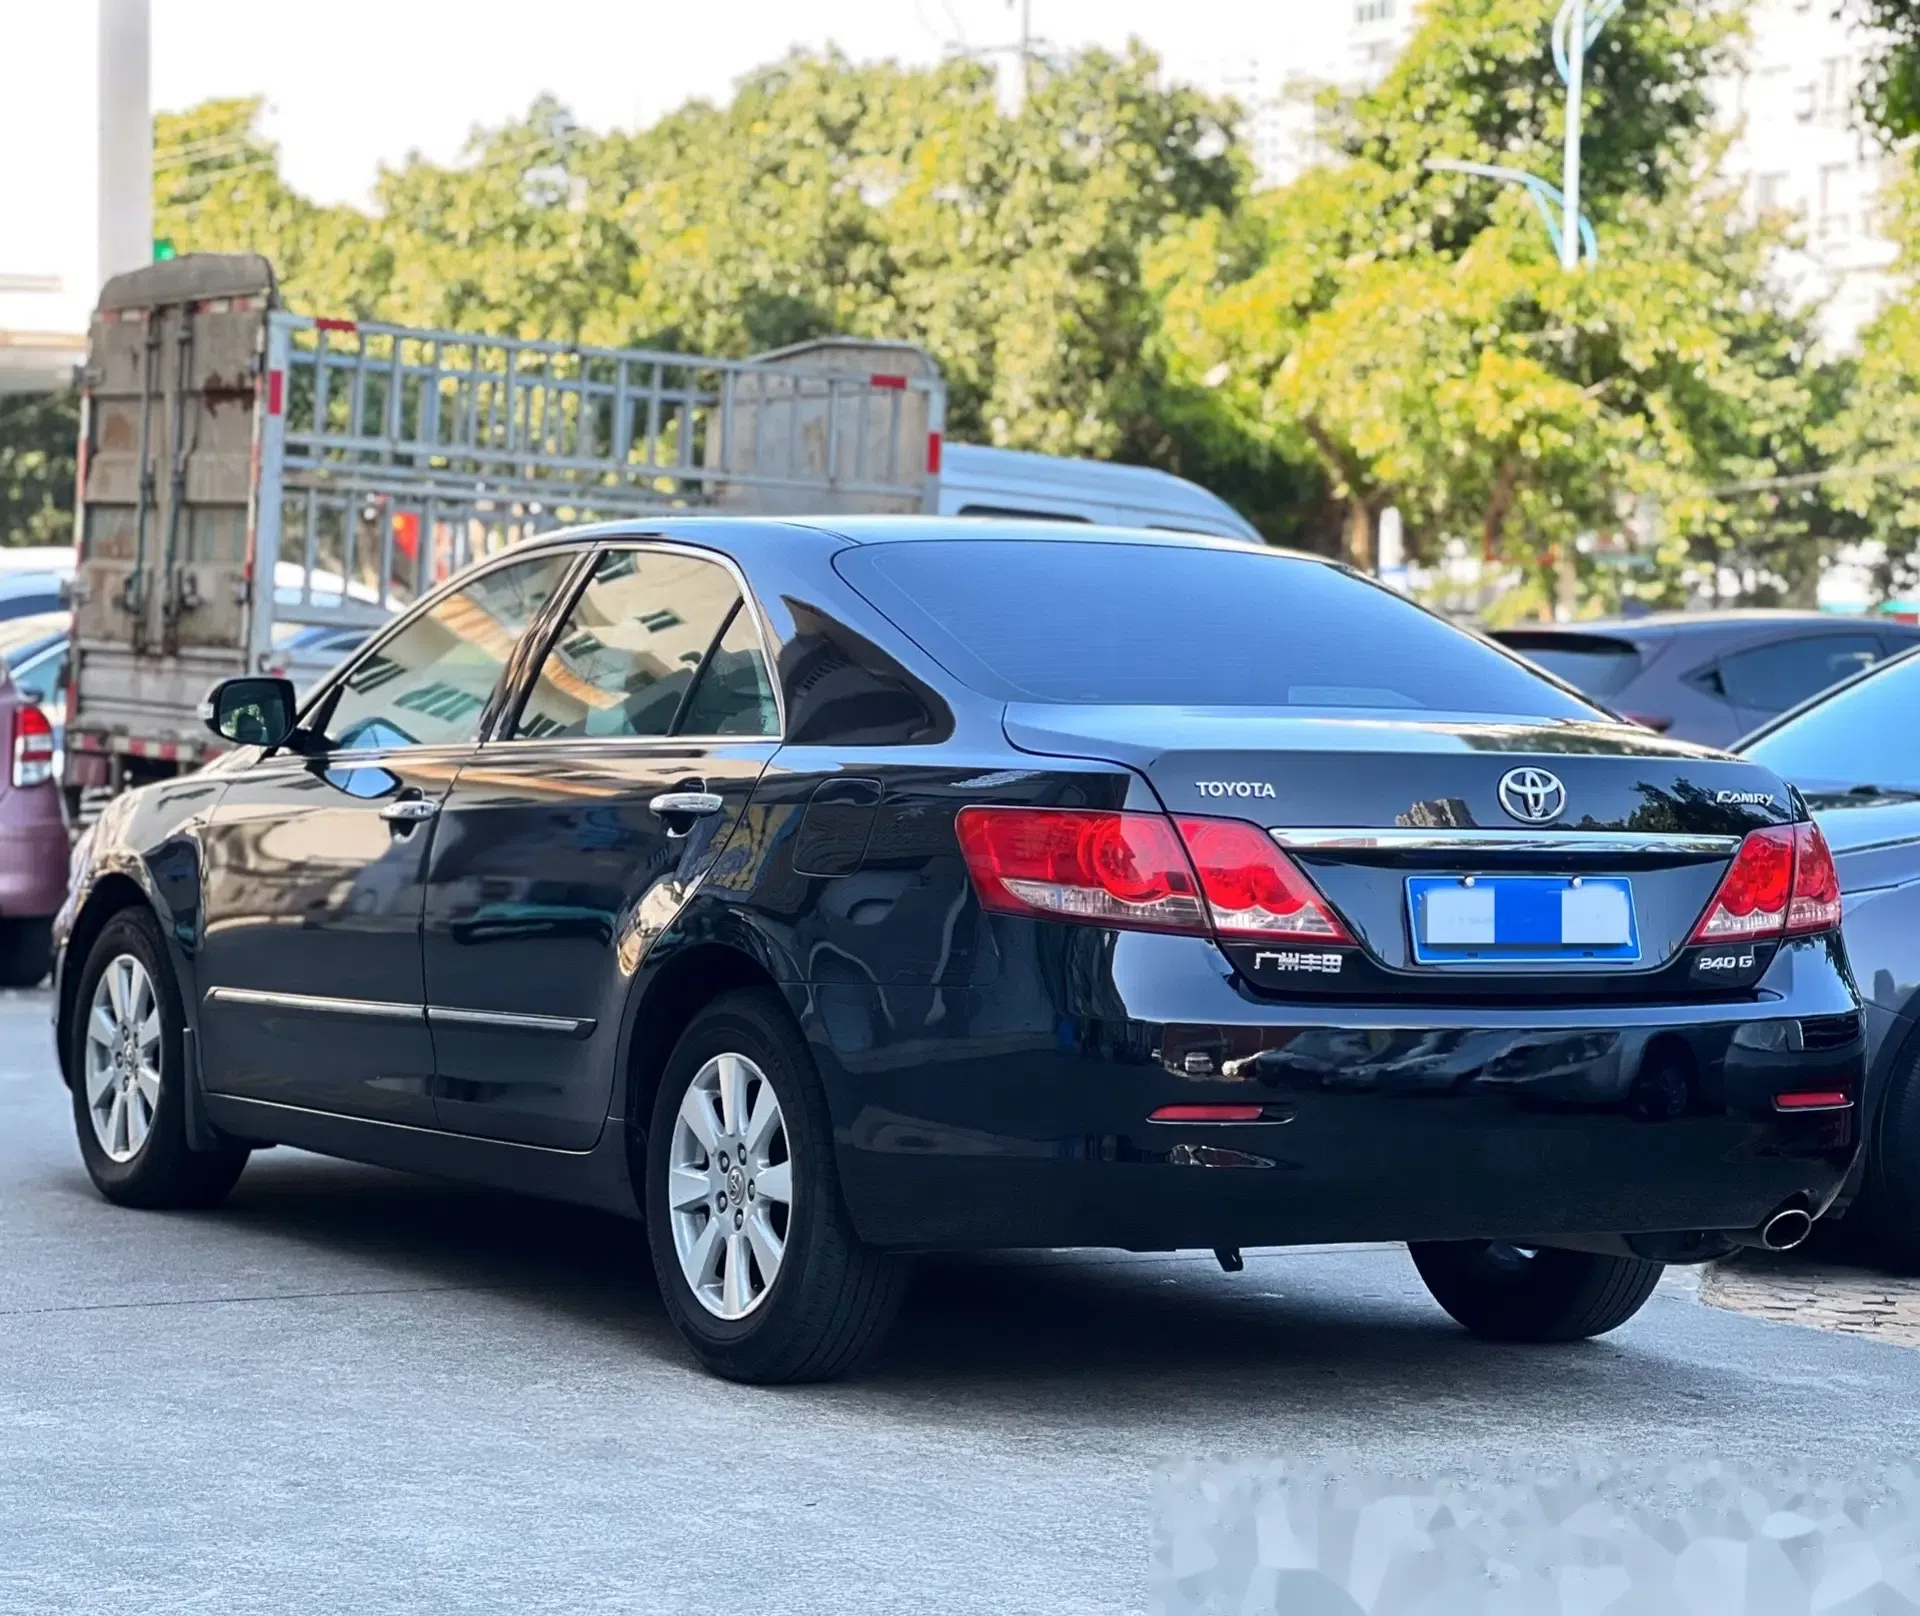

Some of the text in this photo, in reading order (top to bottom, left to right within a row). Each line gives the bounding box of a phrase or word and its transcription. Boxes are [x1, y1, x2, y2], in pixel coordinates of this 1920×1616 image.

[1195, 781, 1276, 798] TOYOTA
[1716, 790, 1774, 806] CAMRY
[1253, 951, 1342, 973] 广州丰田
